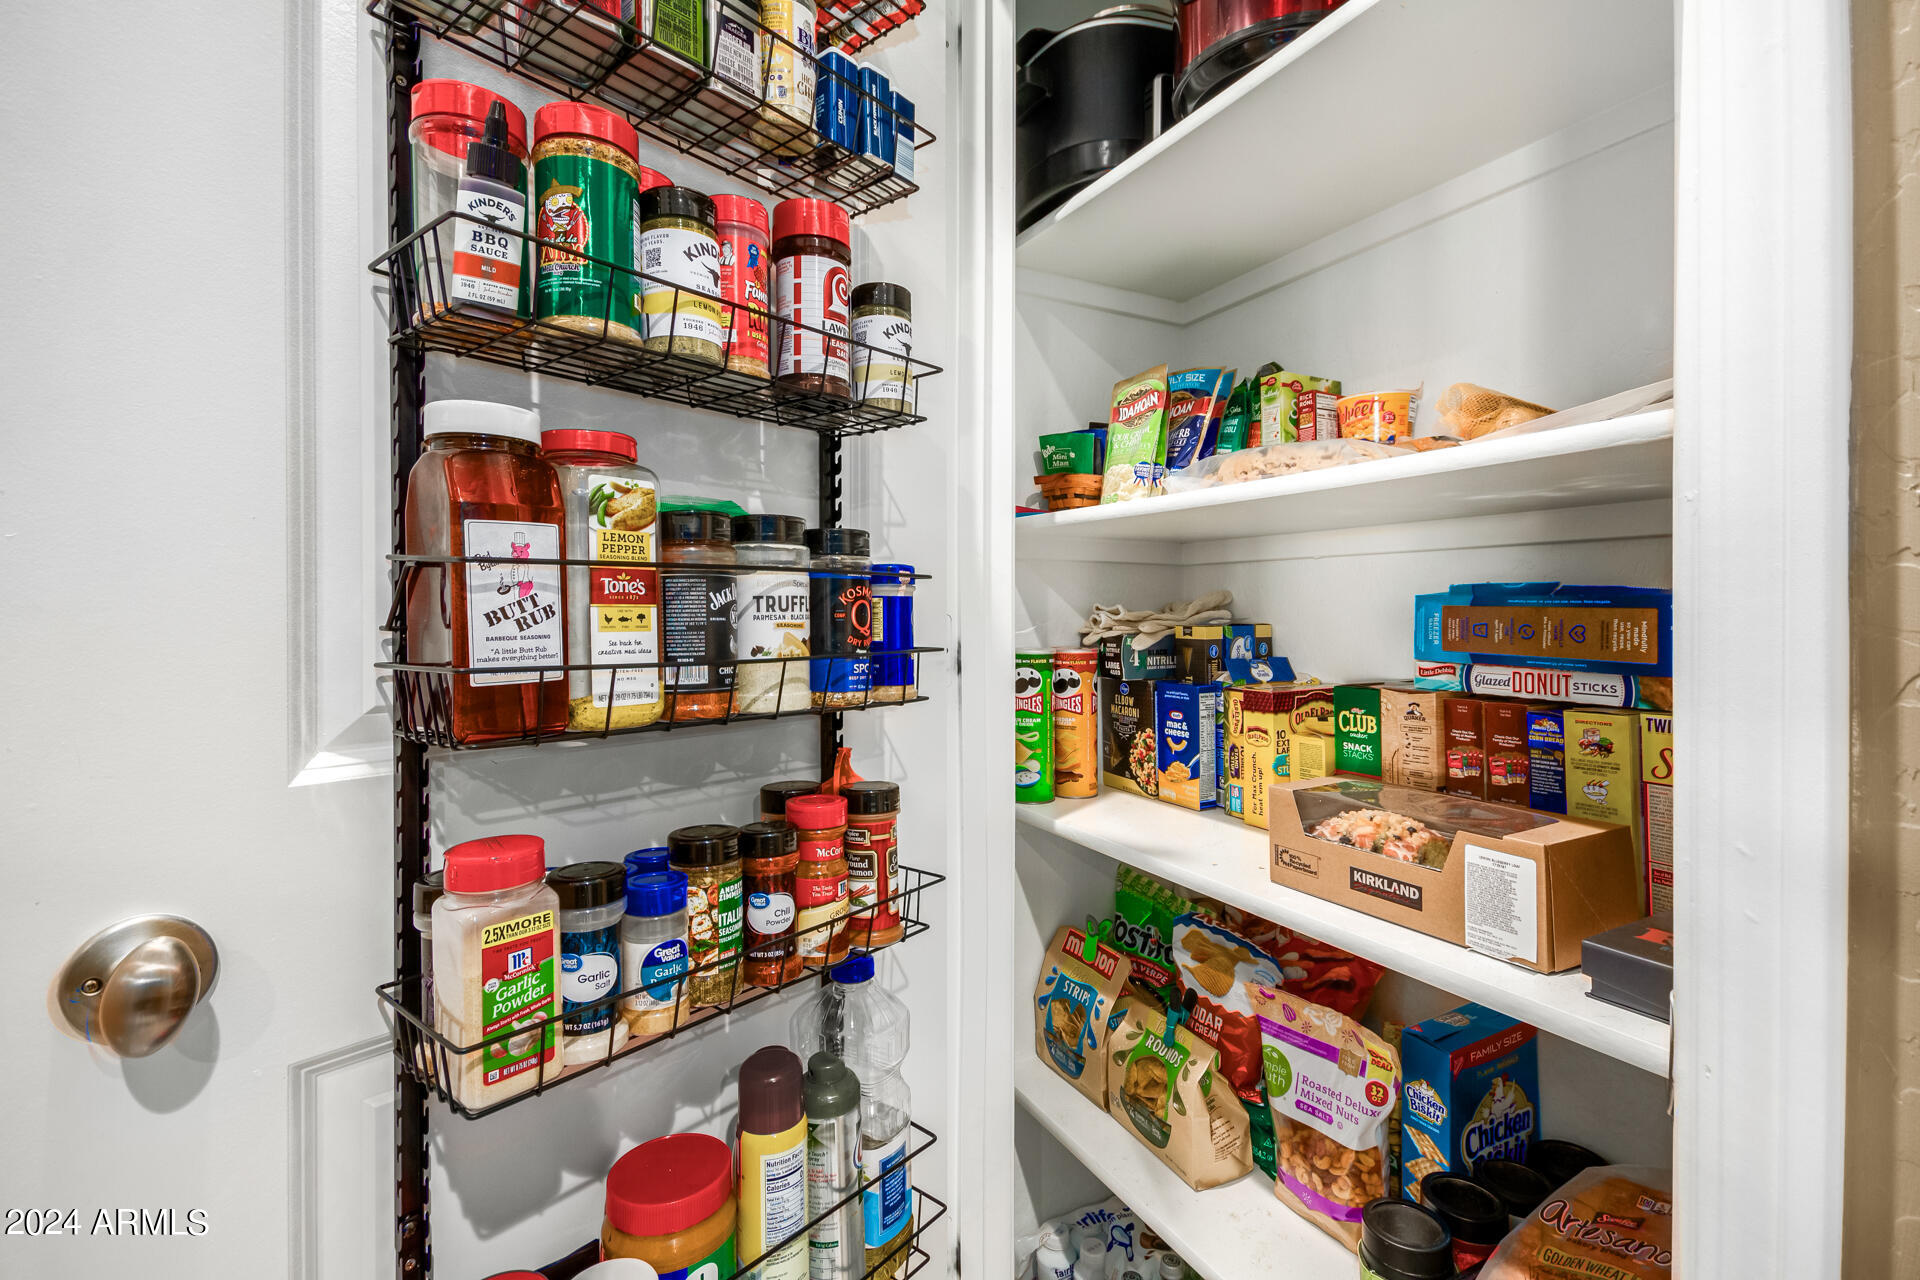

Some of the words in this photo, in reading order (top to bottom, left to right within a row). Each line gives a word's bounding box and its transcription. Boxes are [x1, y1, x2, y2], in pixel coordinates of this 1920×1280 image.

[467, 198, 517, 222] KINDER'S
[472, 230, 508, 250] BBQ
[471, 245, 508, 259] SAUCE
[683, 242, 720, 263] KIND
[481, 264, 497, 273] MILD
[684, 322, 703, 332] 1946
[1185, 374, 1205, 382] SIZE
[1300, 393, 1312, 401] RICE
[1118, 391, 1159, 422] IDAHOAN
[602, 532, 644, 544] LEMON
[601, 543, 646, 555] PEPPER
[600, 577, 646, 595] Tone's
[709, 587, 732, 610] JACK
[483, 593, 541, 628] BUTT
[851, 600, 870, 636] Q
[513, 604, 556, 633] RUB
[1432, 613, 1440, 645] FREEZER
[1640, 620, 1648, 653] Mindfully
[848, 636, 862, 647] DRY
[476, 655, 500, 663] makes
[502, 653, 537, 662] everything
[502, 646, 517, 655] little
[519, 646, 534, 654] Butt
[1105, 661, 1120, 669] LARGE
[1419, 668, 1434, 677] Little
[1435, 665, 1454, 676] Debbie
[1474, 673, 1511, 688] Glazed
[1512, 671, 1572, 697] DONUT
[1572, 682, 1618, 694] STICKS
[1114, 694, 1135, 706] ELBOW
[1110, 704, 1140, 718] MACARONI
[1166, 720, 1181, 730] mac
[1182, 722, 1188, 730] &
[1338, 710, 1377, 733] CLUB
[1276, 730, 1286, 740] 10
[1343, 742, 1373, 753] SNACK
[1343, 750, 1374, 761] STACKS
[816, 848, 843, 858] McCor
[1290, 859, 1311, 869] Recycled
[1353, 870, 1420, 900] KIRKLAND
[774, 907, 791, 918] Chili
[484, 924, 506, 945] 2.5X
[506, 913, 551, 933] MORE
[766, 916, 791, 927] Powder
[654, 944, 680, 958] Great
[661, 953, 680, 963] Value
[1066, 934, 1116, 976] miion
[504, 966, 536, 980] McCormick
[577, 969, 610, 984] Garlic
[655, 963, 682, 978] Garlic
[1137, 964, 1168, 985] VERDE
[496, 972, 540, 1002] Garlic
[595, 978, 611, 990] Salt
[492, 982, 547, 1019] Powder
[1062, 980, 1091, 1006] STRIPS
[565, 1023, 574, 1031] WT
[574, 1023, 582, 1031] 5.7
[1195, 1024, 1218, 1043] CREAM
[1470, 1042, 1503, 1063] FAMILY
[1503, 1031, 1523, 1048] SIZE
[1301, 1074, 1342, 1102] Roasted
[1371, 1084, 1384, 1096] 32
[1300, 1087, 1333, 1112] Mixed
[1335, 1104, 1359, 1126] Nuts
[1406, 1085, 1445, 1115] Chicken
[1300, 1103, 1313, 1114] SEA
[1314, 1108, 1331, 1121] SALT
[1410, 1099, 1441, 1123] Biskit
[1465, 1109, 1531, 1159] Chicken
[766, 1156, 792, 1168] Nutrition
[766, 1182, 790, 1192] Calories
[1542, 1248, 1584, 1271] GOLDEN
[1586, 1260, 1630, 1280] WHEAT
